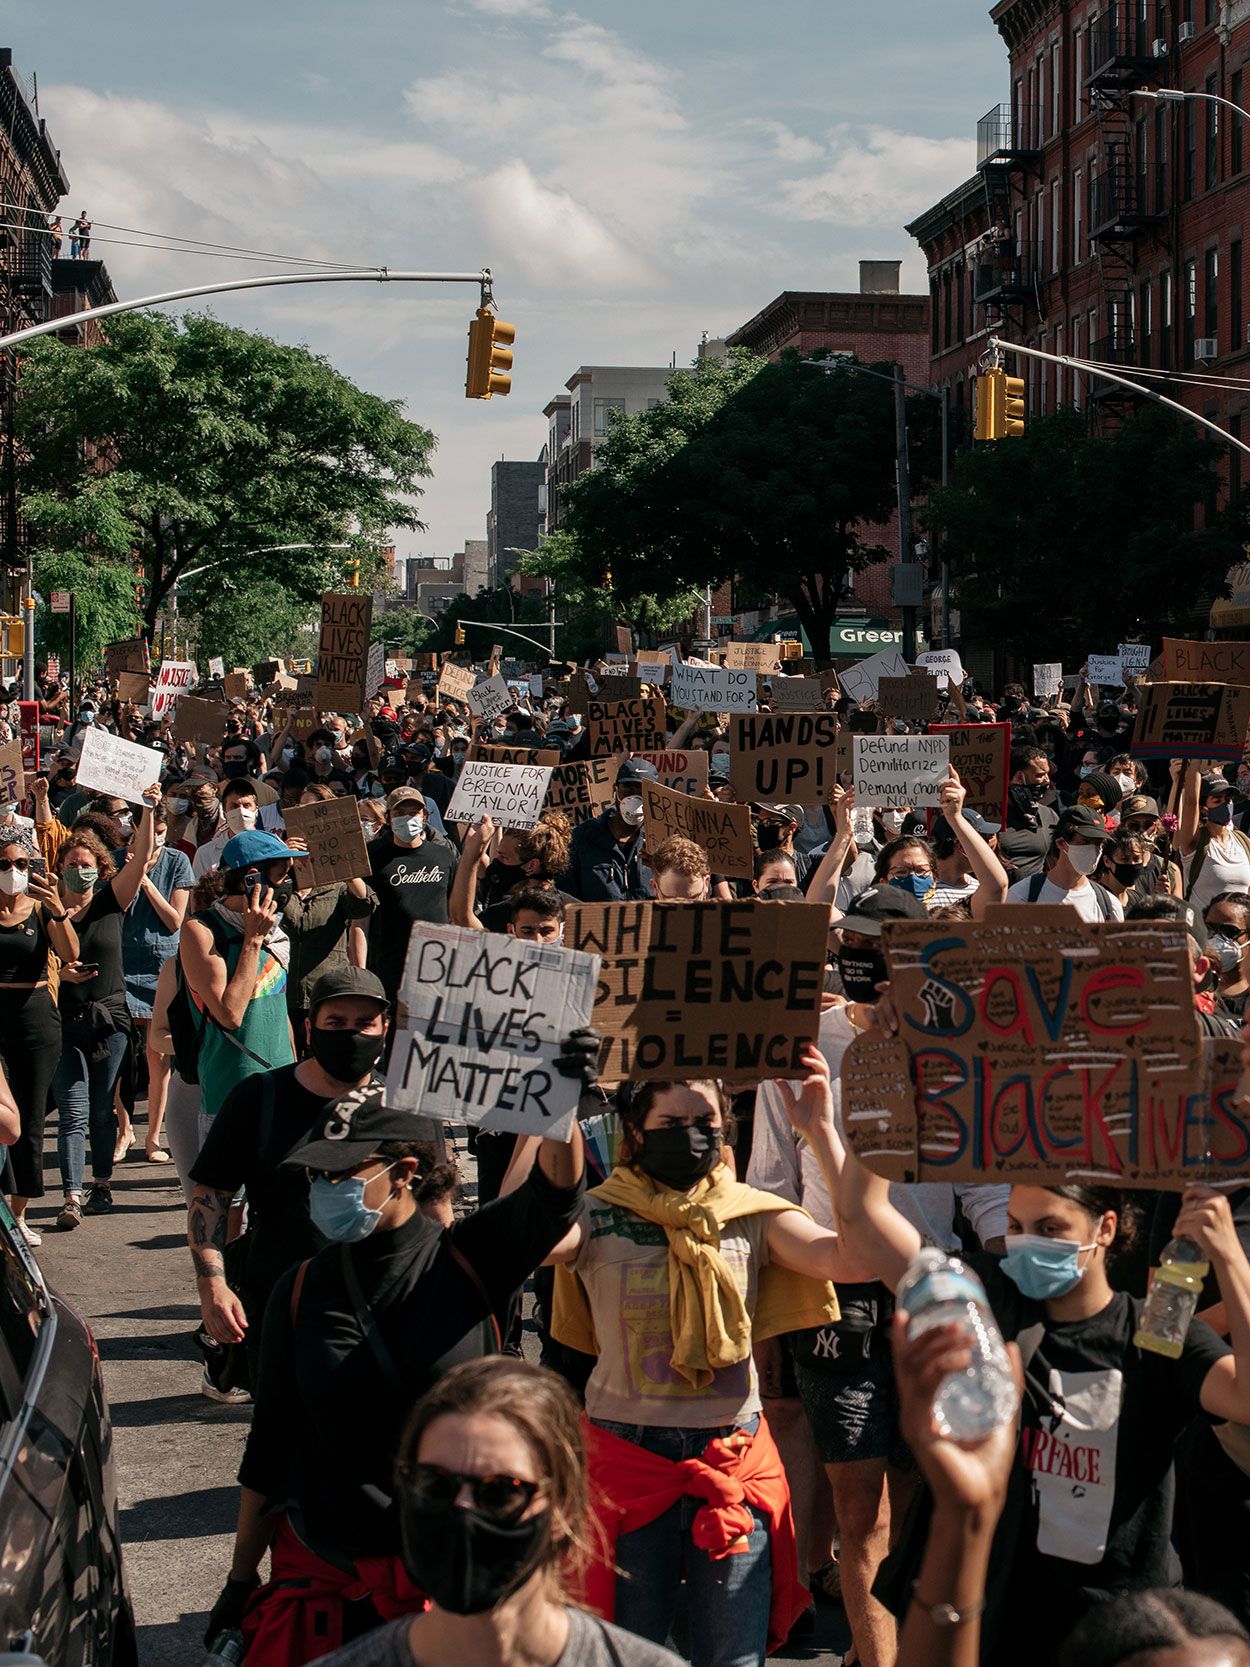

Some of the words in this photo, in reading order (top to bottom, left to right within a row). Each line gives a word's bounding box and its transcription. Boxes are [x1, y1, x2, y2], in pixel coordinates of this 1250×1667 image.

[322, 602, 365, 627] BLACK
[320, 629, 363, 655] LIVES
[317, 656, 362, 684] MATTER
[1176, 649, 1245, 671] BLACK
[445, 665, 473, 683] DEFUND
[675, 667, 720, 685] WHAT
[728, 672, 748, 684] DO
[440, 683, 466, 699] POLICE
[471, 685, 495, 701] Black
[164, 693, 176, 712] PEA
[480, 700, 511, 720] Matter
[589, 701, 656, 721] BLACK
[599, 718, 655, 735] LIVES
[739, 715, 836, 751] HANDS
[594, 732, 665, 753] MATTER
[860, 737, 909, 753] Defund
[918, 738, 947, 755] NYPD
[476, 748, 538, 765] BLACK
[859, 757, 938, 774] Demilitarize
[953, 753, 993, 766] OOTING
[465, 762, 510, 778] JUSTICE
[520, 766, 545, 787] FOR
[756, 757, 823, 796] UP!
[461, 778, 538, 799] BREONNA
[543, 786, 590, 808] LICE
[859, 779, 907, 796] Demand
[912, 781, 942, 796] Chan
[887, 795, 918, 807] NOW
[313, 806, 328, 818] NO
[446, 808, 475, 822] BLACK
[481, 817, 503, 828] LES
[508, 819, 537, 831] MATTER
[648, 791, 737, 837] BREONNA
[308, 816, 357, 835] JUSTICE
[319, 837, 339, 851] NO
[712, 854, 748, 867] IVES
[574, 904, 754, 953] WHITE
[417, 941, 541, 1000] BLACK
[597, 957, 820, 1010] SILENCE
[425, 996, 546, 1053] LIVES
[599, 1034, 814, 1074] VIOLENCE
[402, 1037, 553, 1117] MATTER
